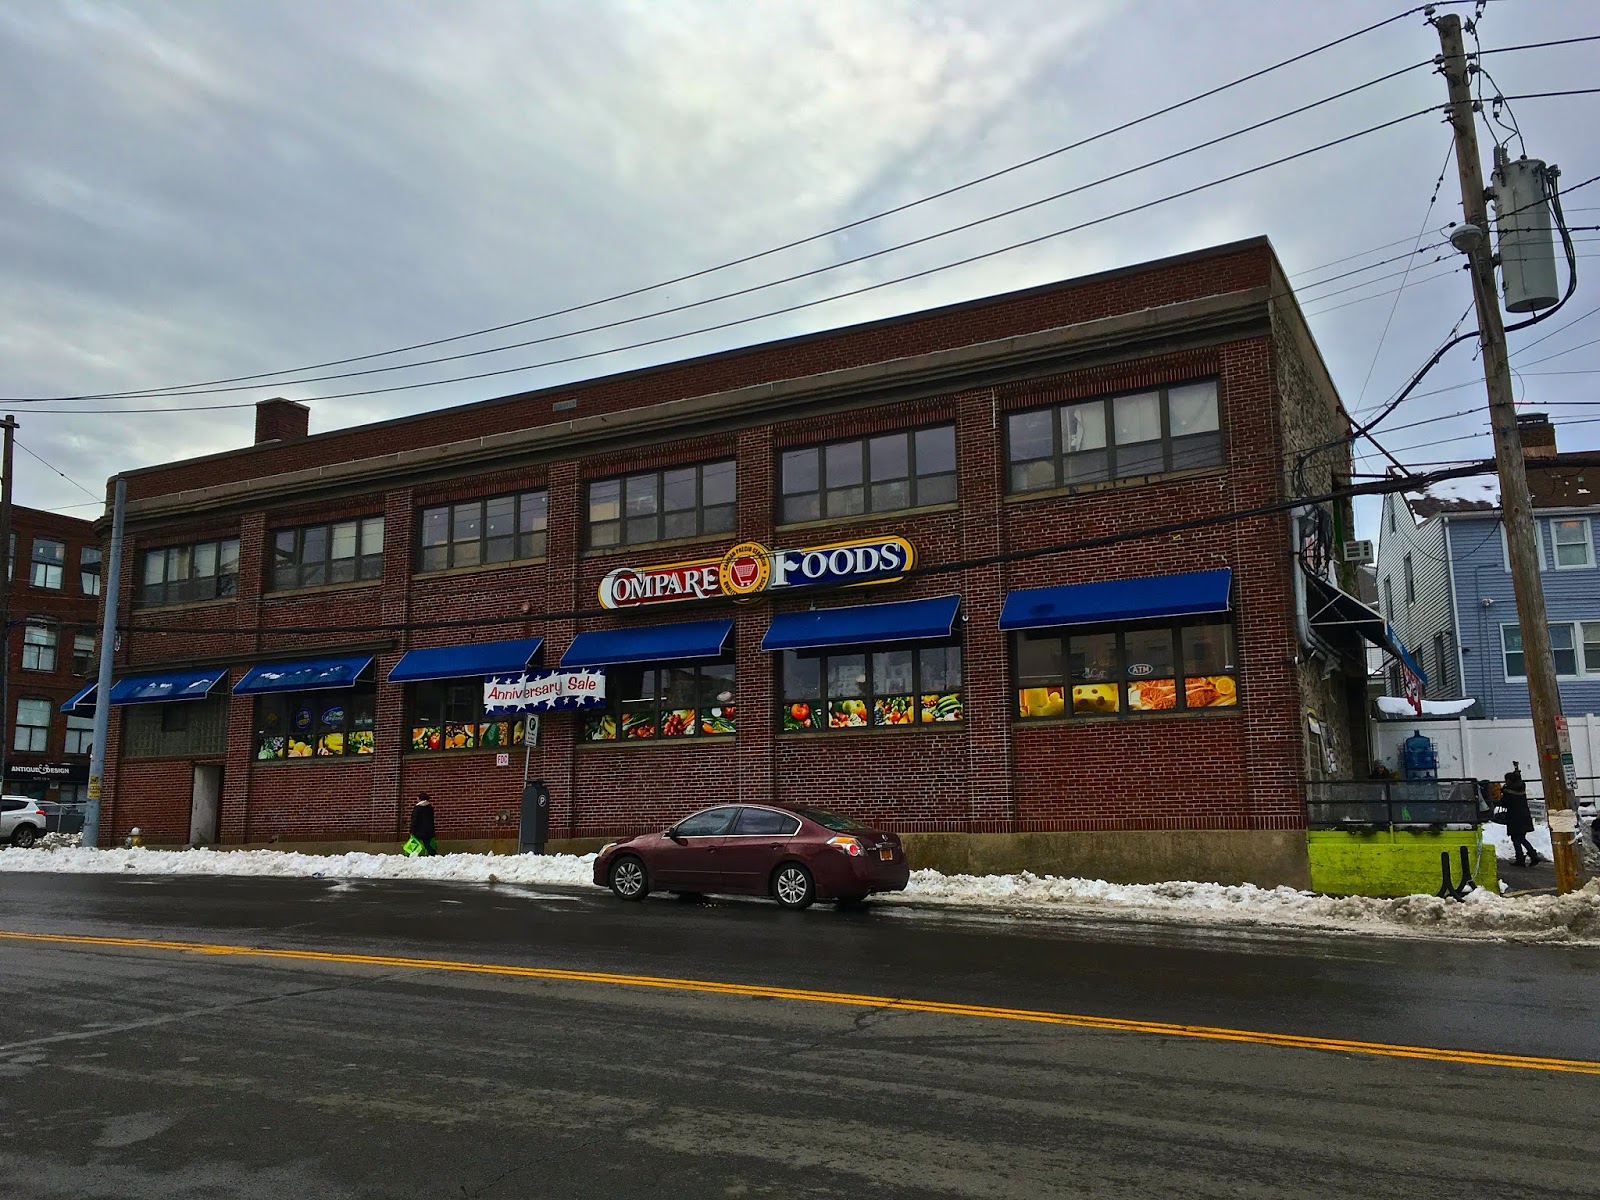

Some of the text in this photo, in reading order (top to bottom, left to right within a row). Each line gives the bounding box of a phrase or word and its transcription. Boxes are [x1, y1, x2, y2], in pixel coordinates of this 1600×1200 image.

[599, 543, 902, 609] COMPARE FOODS
[488, 675, 596, 700] Anniversary Sale
[498, 755, 507, 764] FDC
